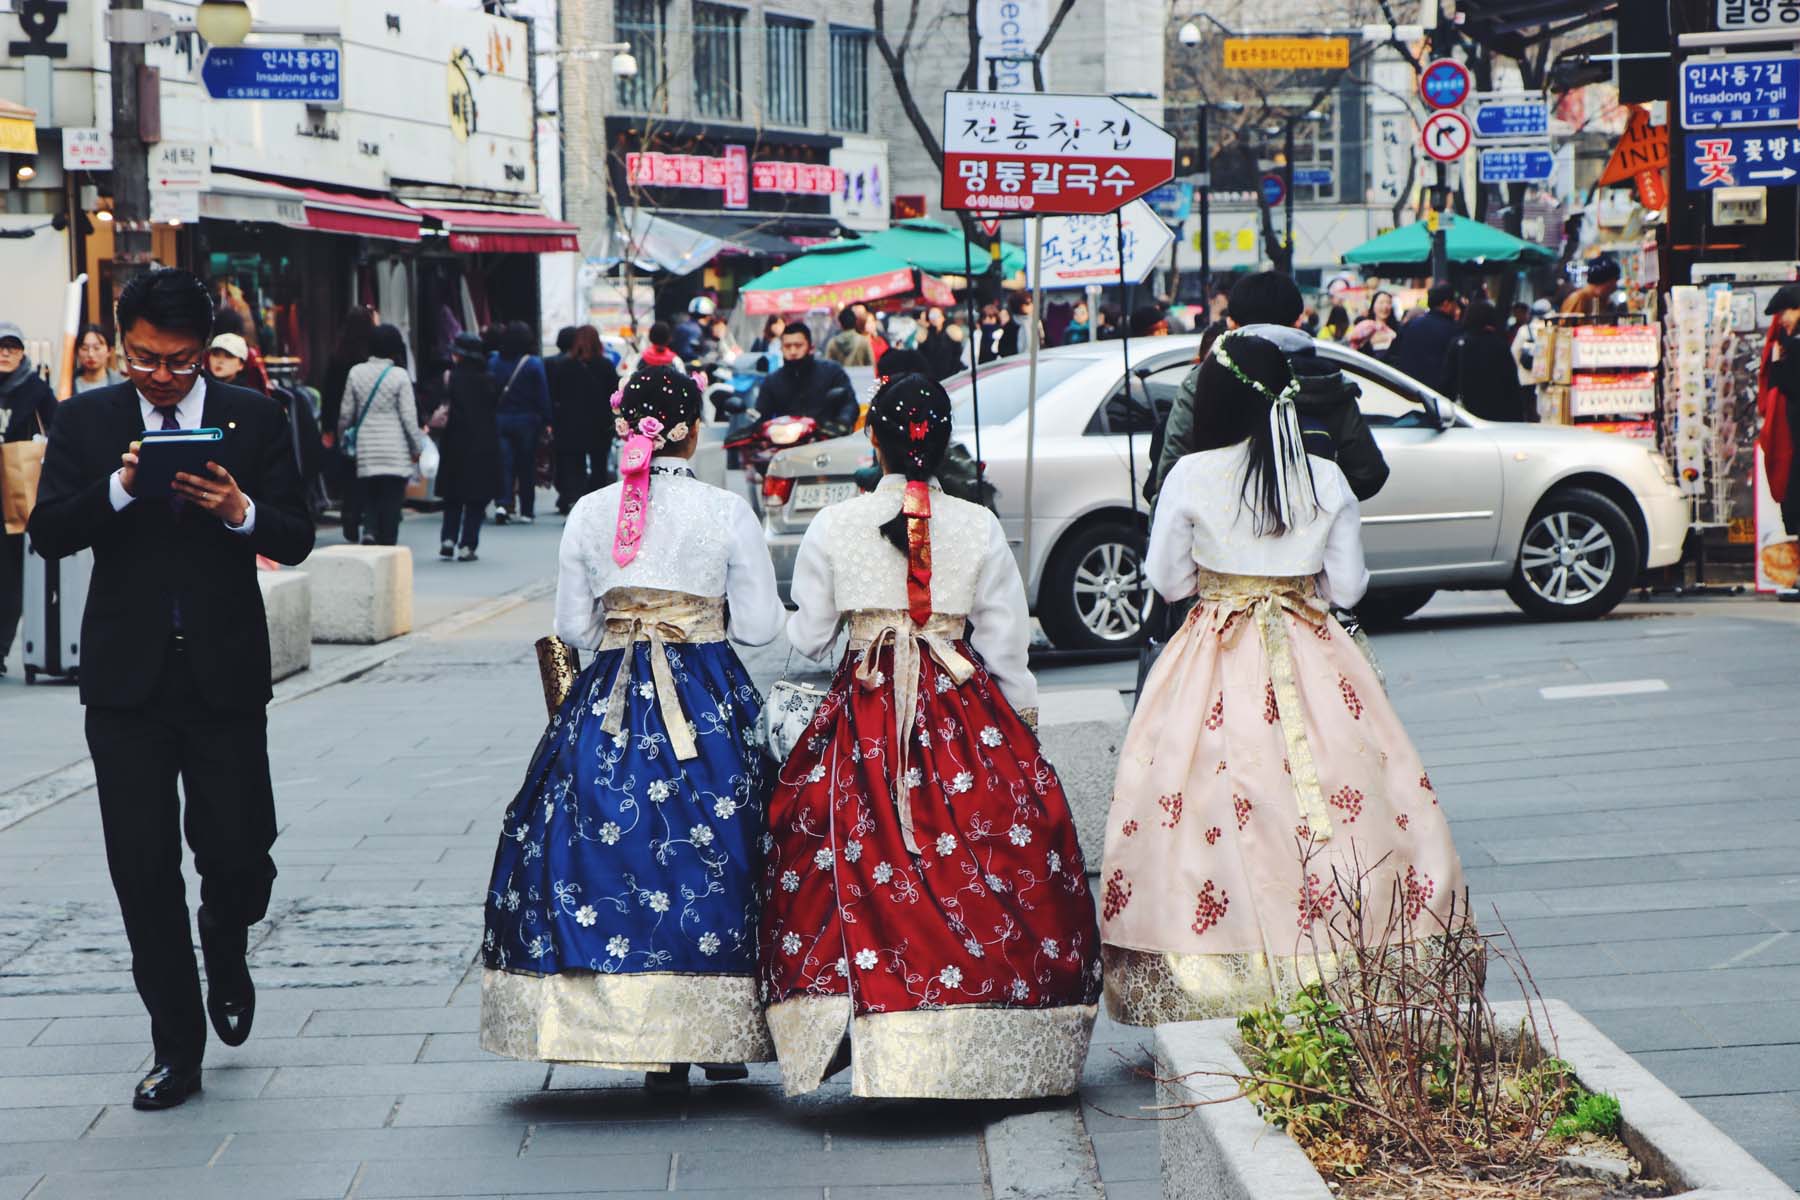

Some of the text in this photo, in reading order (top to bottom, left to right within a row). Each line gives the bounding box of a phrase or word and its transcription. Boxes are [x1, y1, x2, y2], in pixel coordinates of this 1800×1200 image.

[262, 51, 336, 70] 인사동6길
[256, 72, 337, 85] Insadong 6-gil
[1689, 63, 1782, 88] 인사동7길
[1689, 87, 1787, 104] Insadong 7-gil
[162, 147, 195, 164] 세탁
[1694, 138, 1737, 186] 꽃
[958, 159, 1136, 196] 명동칼국수
